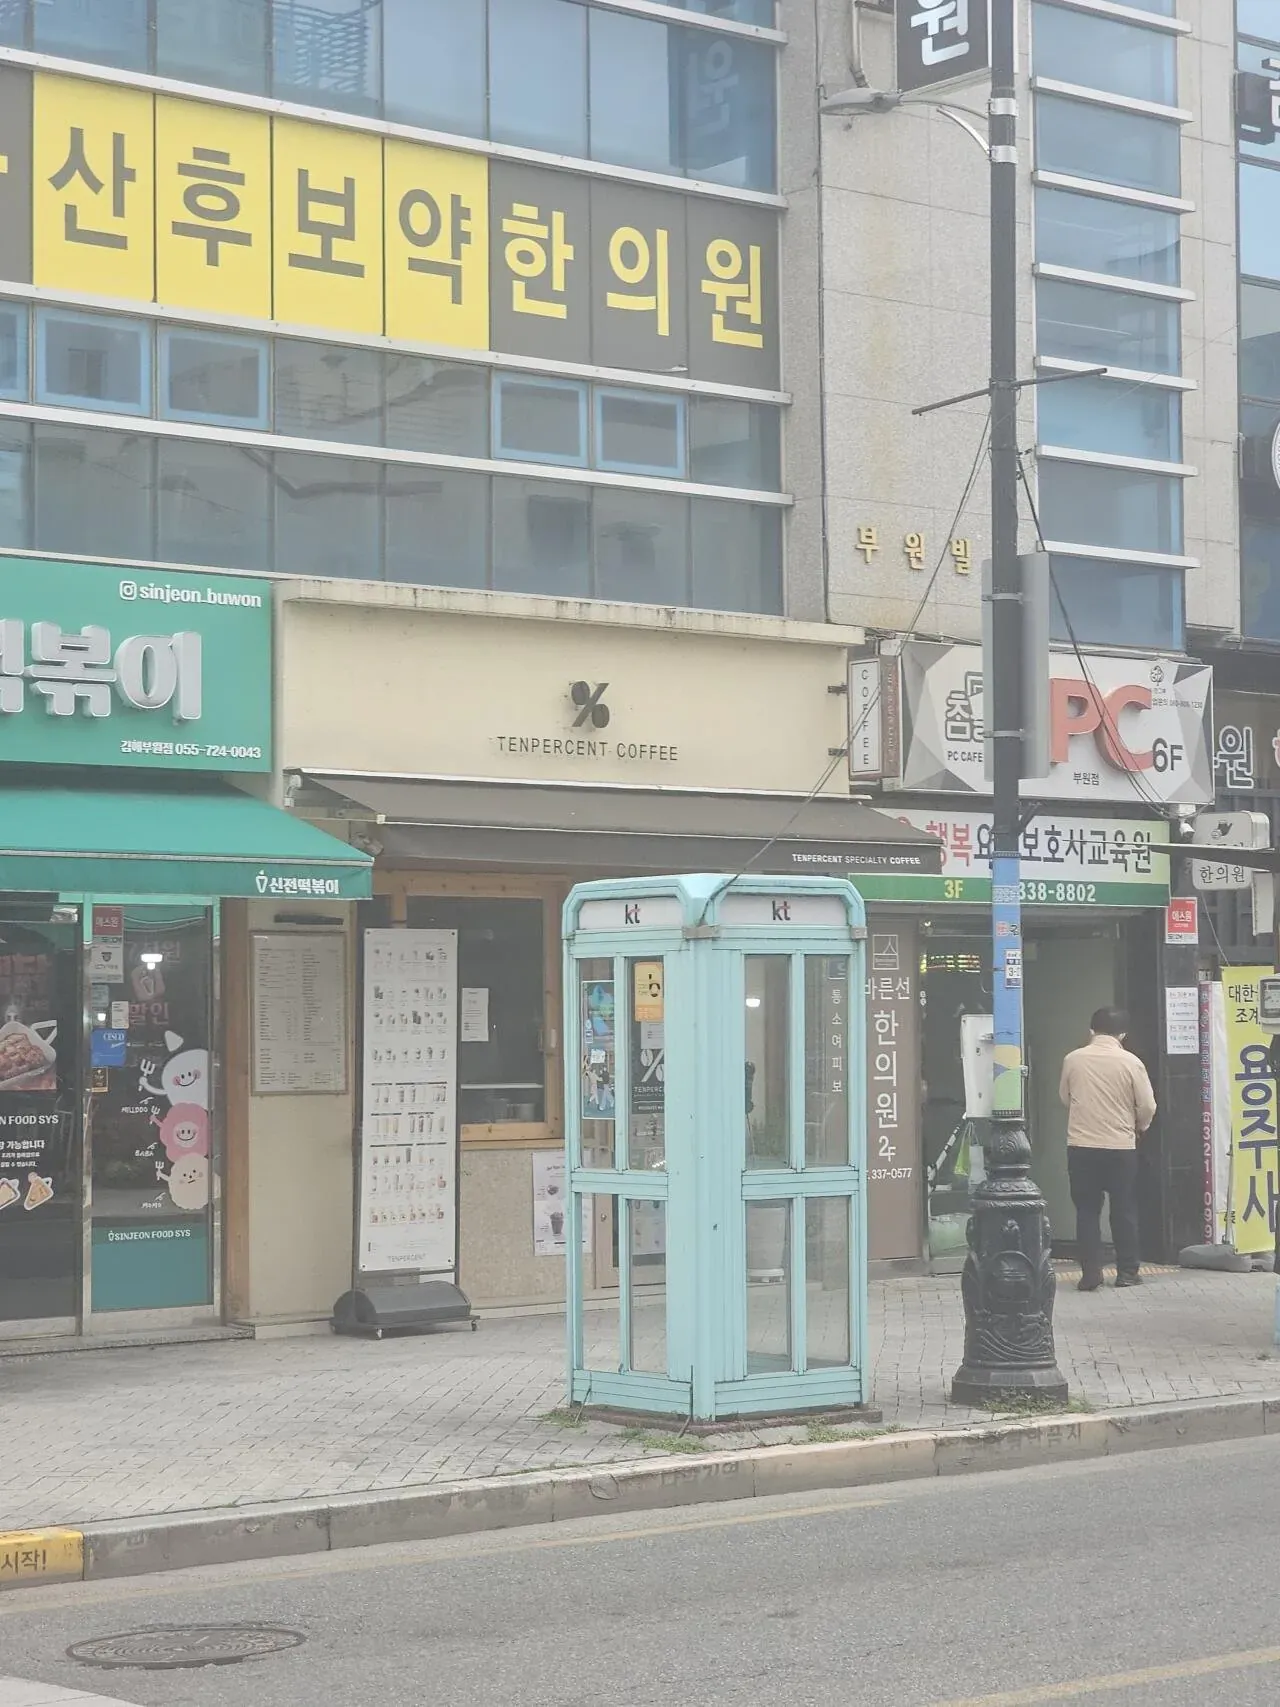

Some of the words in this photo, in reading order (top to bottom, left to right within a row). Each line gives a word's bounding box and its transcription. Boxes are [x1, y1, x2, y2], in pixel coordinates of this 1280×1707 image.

[910, 0, 969, 66] 원
[139, 582, 261, 607] sinjeon_buwon
[861, 669, 870, 766] COFFEE
[1050, 677, 1153, 772] PC
[120, 740, 173, 755] 김해부원점
[174, 743, 261, 759] 055-724-0043
[497, 736, 608, 756] TENPERCENT
[616, 742, 678, 761] COFFEE
[947, 750, 959, 761] PC
[1152, 737, 1184, 773] 6F
[1214, 725, 1255, 789] 원
[1073, 771, 1100, 786] 부원점
[792, 853, 843, 863] TENPERCENT
[845, 856, 887, 864] SPECIALTY
[889, 857, 921, 865] COFFEE
[1200, 864, 1245, 884] 한의원
[268, 877, 339, 894] 신전떡볶이
[944, 879, 964, 899] 3F
[625, 903, 641, 924] kt
[772, 900, 791, 921] kt
[1228, 984, 1260, 1003] 대한
[1235, 1006, 1262, 1025] 조계
[873, 1009, 899, 1129] 한의원
[8, 1115, 37, 1125] FOOD
[38, 1114, 59, 1124] SYS
[6, 1140, 45, 1150] 가능합니다
[878, 1135, 897, 1163] 2F
[1234, 1044, 1280, 1234] 용주사
[114, 1231, 151, 1241] SINJEON
[151, 1230, 174, 1239] FOOD
[175, 1229, 191, 1238] SYS
[1, 1549, 47, 1575] 시작!
